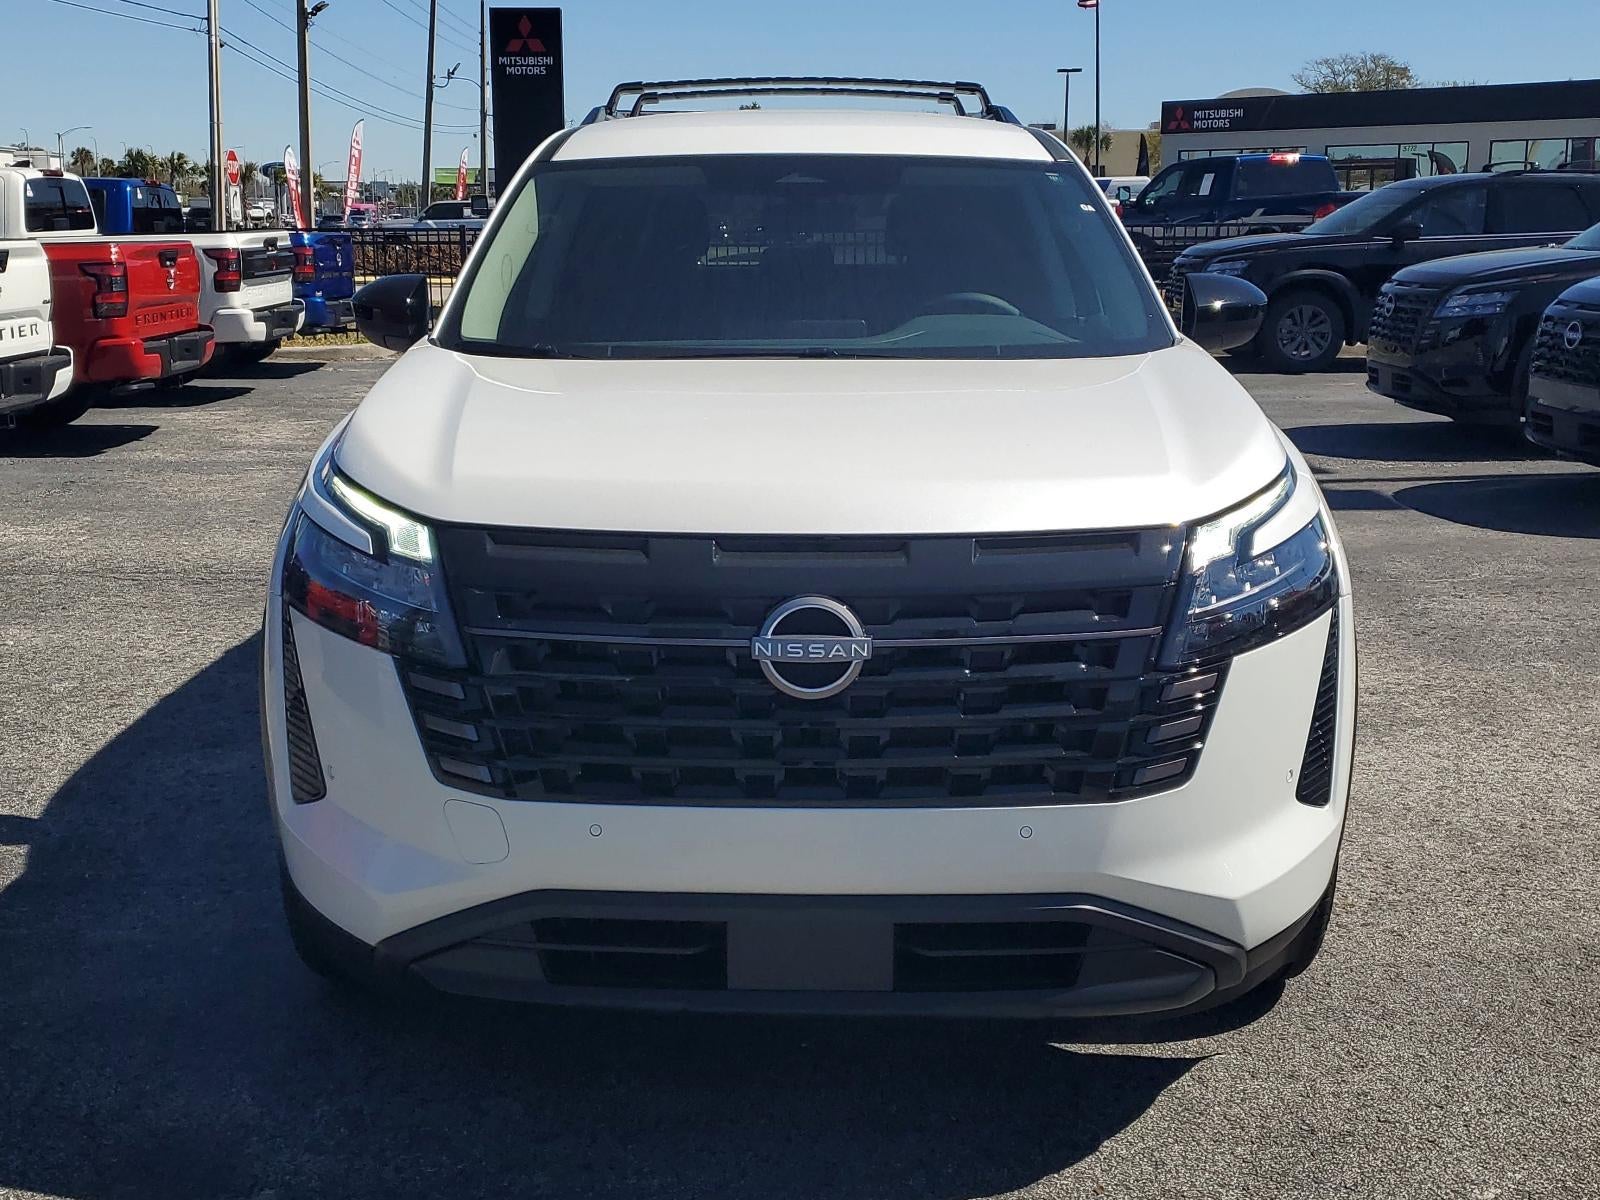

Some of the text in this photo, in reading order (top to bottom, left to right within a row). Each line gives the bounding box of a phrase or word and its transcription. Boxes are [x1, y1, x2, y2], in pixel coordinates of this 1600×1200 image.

[498, 56, 553, 65] MITSUBISHI
[506, 66, 546, 75] MOTORS
[1194, 108, 1243, 119] MITSUBISHI
[1193, 119, 1230, 129] MOTORS
[135, 307, 193, 326] FRONTIER
[755, 642, 868, 658] NISSAN
